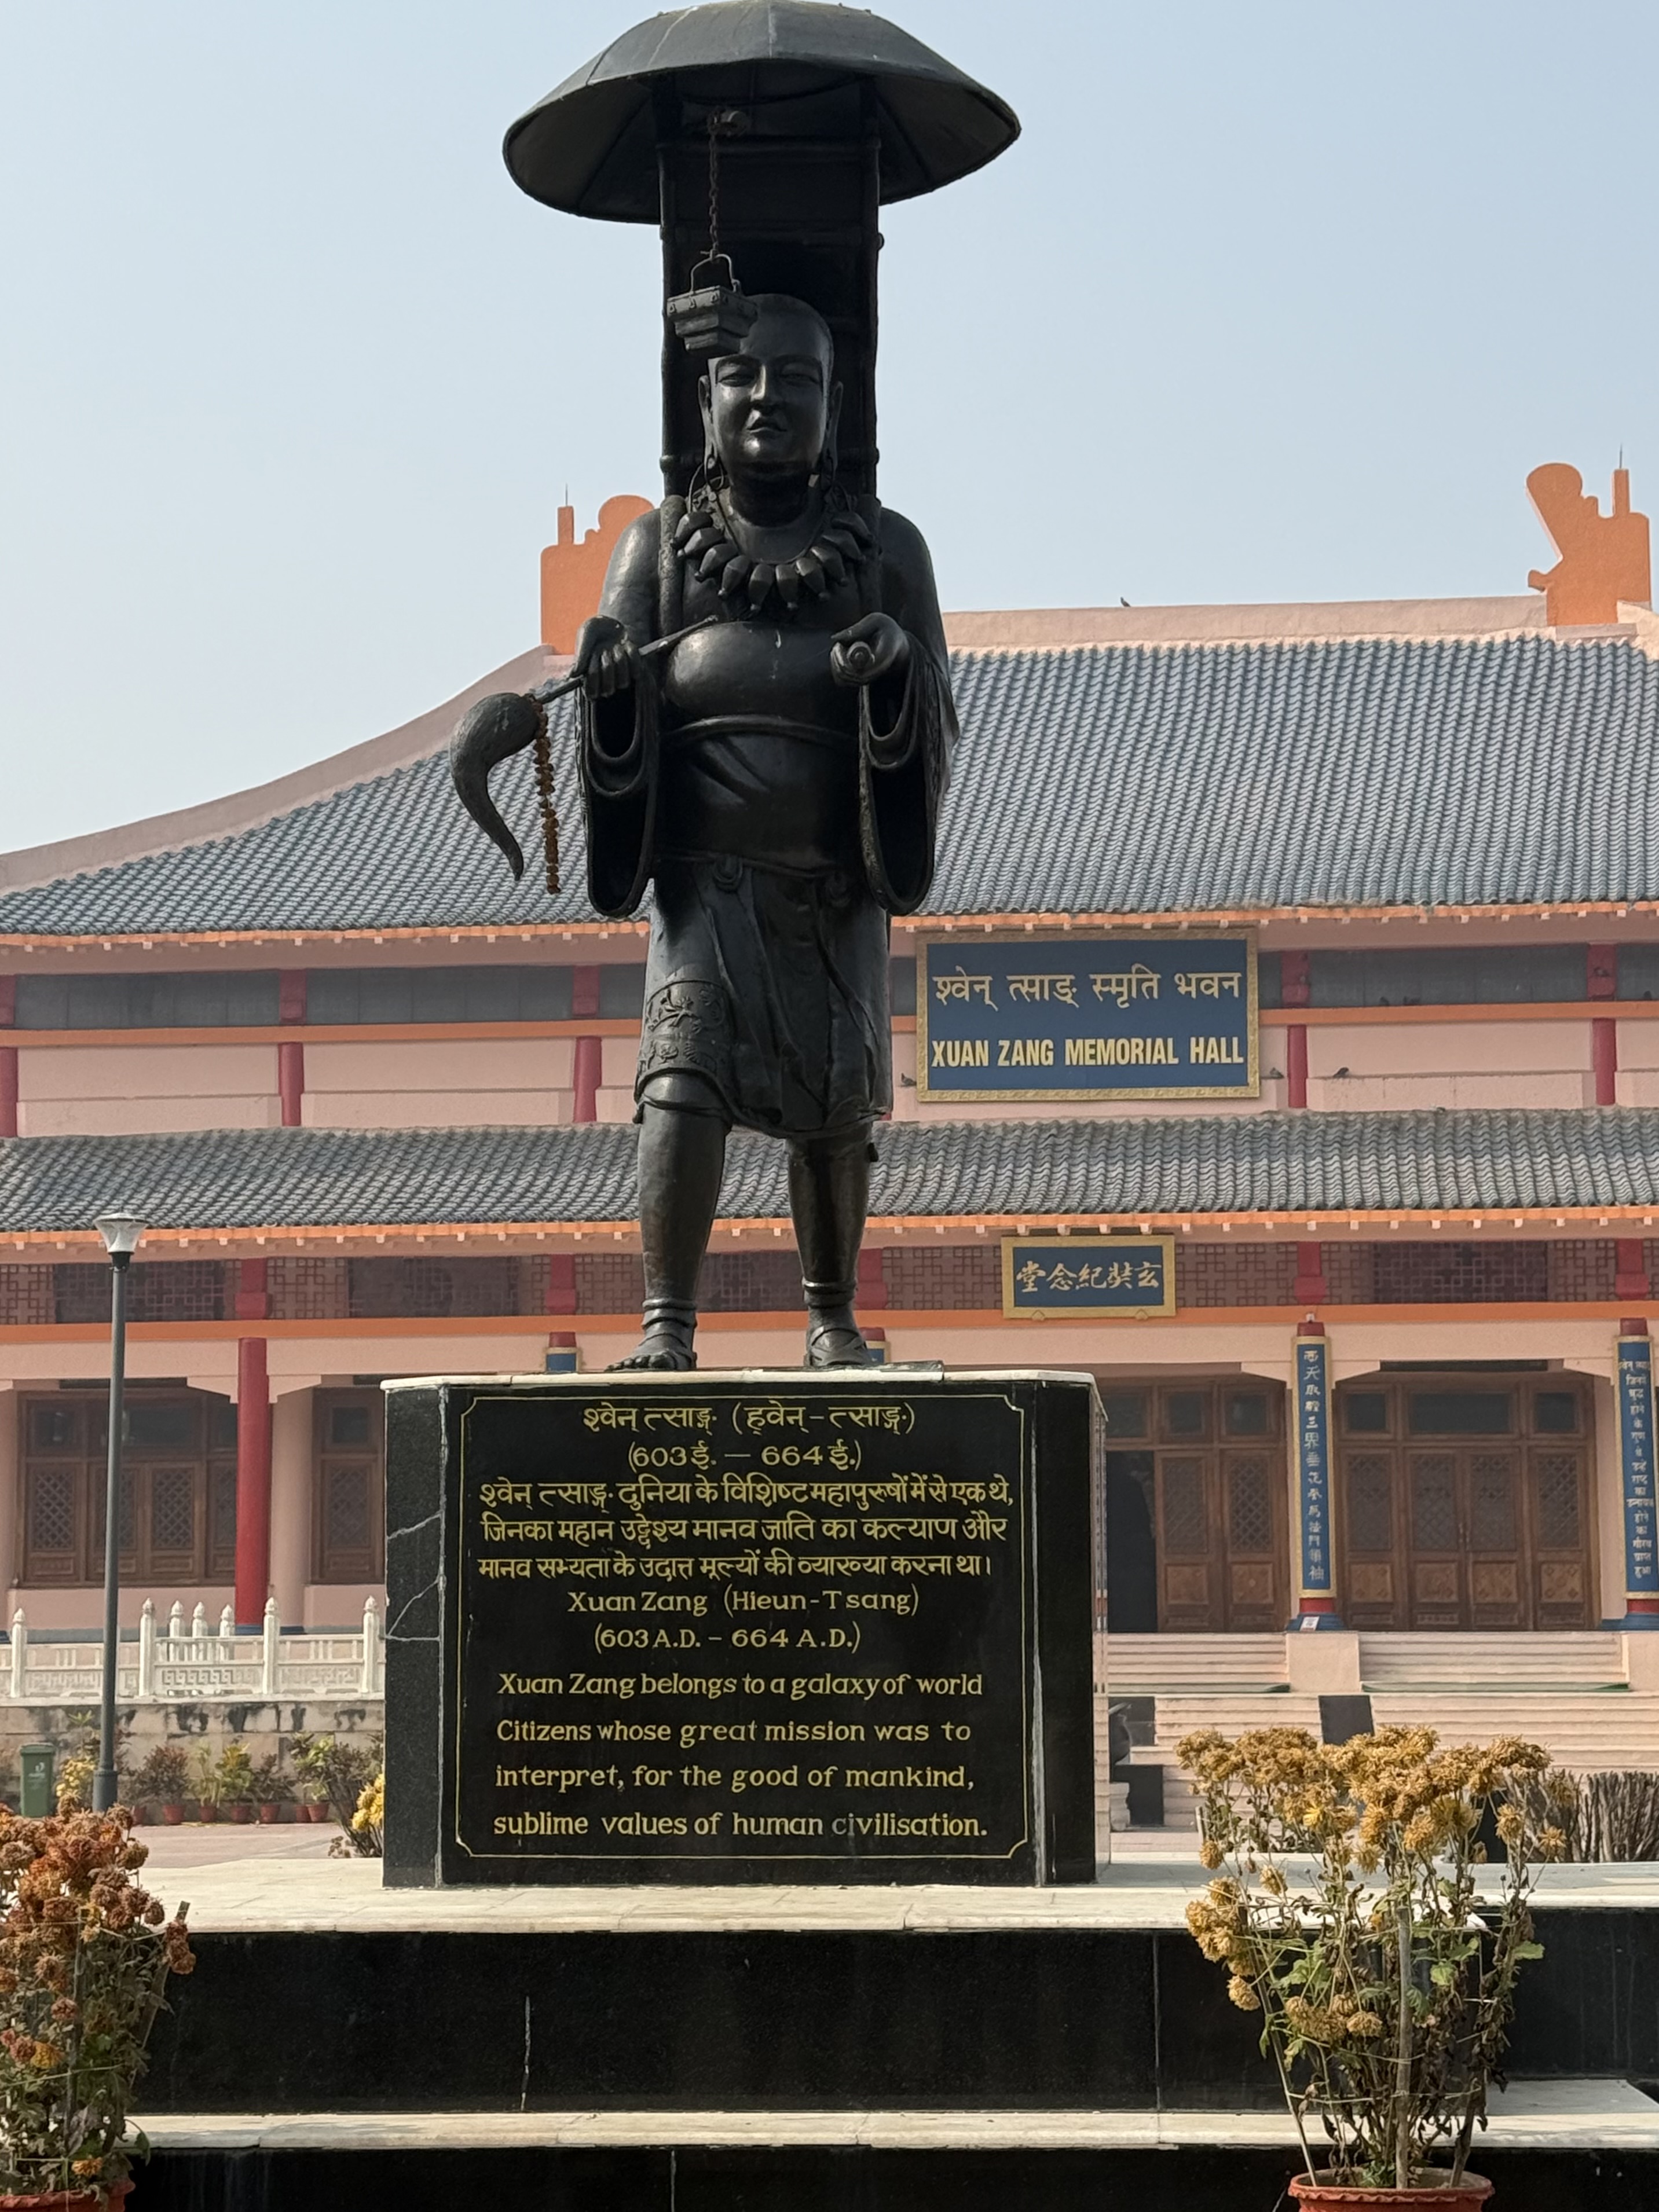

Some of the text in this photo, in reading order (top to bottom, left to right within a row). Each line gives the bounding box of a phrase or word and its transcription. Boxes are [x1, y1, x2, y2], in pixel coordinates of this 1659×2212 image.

[931, 965, 998, 1011] श्वेन्
[1089, 963, 1161, 1008] स्मृति
[1174, 972, 1241, 999] भवन
[931, 1037, 1244, 1068] XUAN ZANG MEMORIAL HALL
[761, 1446, 823, 1466] 664
[616, 1473, 693, 1511] दुनिया
[695, 1474, 718, 1503] के
[720, 1472, 808, 1507] विशिष्ट
[910, 1473, 928, 1503] में
[928, 1474, 948, 1503] से
[948, 1482, 986, 1506] एक
[988, 1473, 1013, 1506] थे,
[480, 1510, 1008, 1549] जिनका महान उद्देश्य मानव जाति का कल्याण और
[477, 1558, 533, 1579] मानव
[613, 1550, 636, 1578] के
[639, 1557, 695, 1582] उदात्त
[698, 1549, 761, 1581] मूल्यों
[764, 1547, 795, 1576] की
[797, 1556, 888, 1576] व्याख्या
[891, 1556, 953, 1576] करना
[568, 1591, 636, 1612] Xuan
[641, 1591, 708, 1617] Zang
[732, 1628, 789, 1648] 664
[497, 1672, 982, 1701] Xuan Zang belongs to a galaxy of world
[497, 1719, 971, 1748] Citizens whose great mission was to
[496, 1765, 975, 1793] interpret, for the good of mankind,
[494, 1811, 987, 1836] sublime values of human civilisation.
